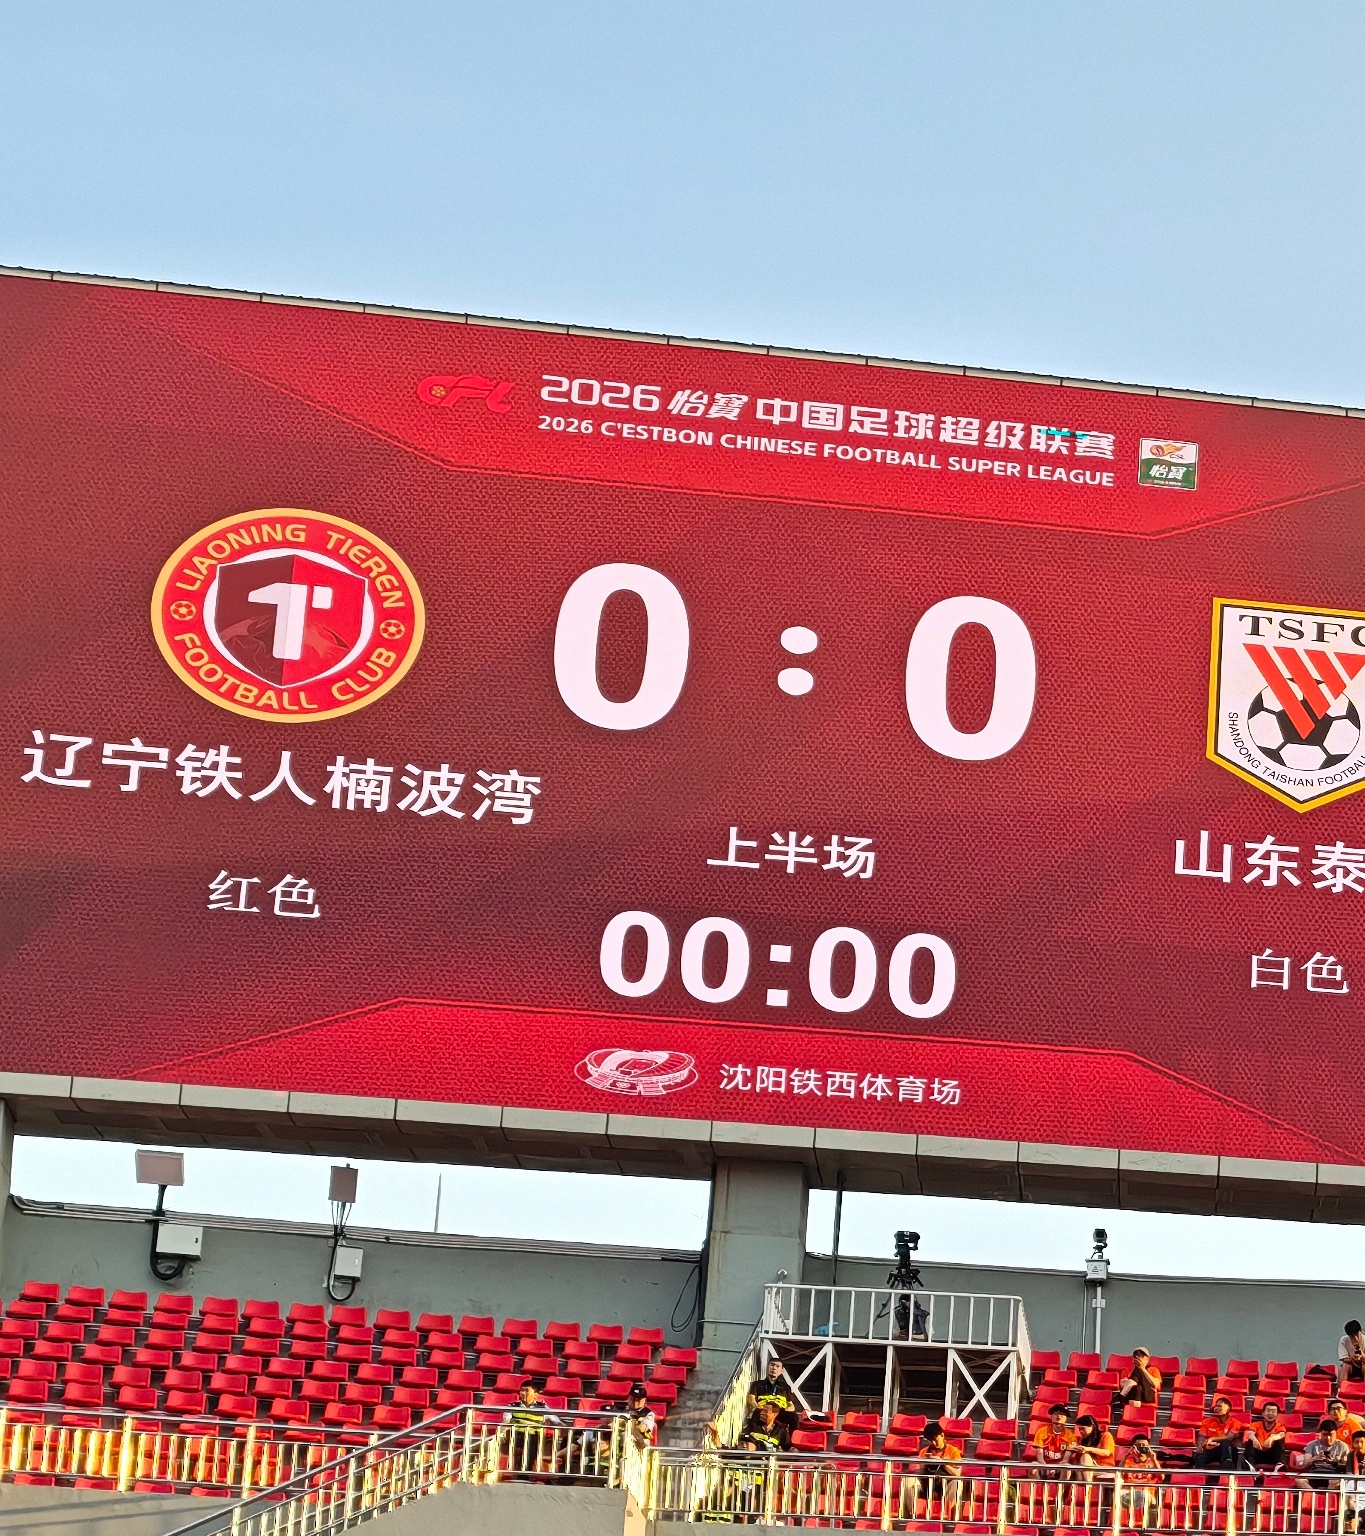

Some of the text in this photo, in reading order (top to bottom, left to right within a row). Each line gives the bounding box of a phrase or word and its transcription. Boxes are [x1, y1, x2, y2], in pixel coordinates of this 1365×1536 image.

[537, 415, 1115, 488] 2026 C'ESTBON CHINESE FOOTBALL SUPER LEAGUE
[539, 374, 663, 412] 2026
[754, 396, 1117, 460] 中国足球超级联赛
[176, 523, 405, 609] LIAONING TIEREN
[174, 632, 397, 710] FOOTBALL CLUB
[553, 562, 691, 732] 0
[904, 595, 1038, 762] 0
[21, 728, 543, 828] 辽宁铁人楠波湾
[1228, 711, 1261, 770] SHANDONG
[1263, 765, 1315, 787] TAISHAN
[706, 825, 876, 881] 上半场
[206, 868, 322, 921] 红色
[599, 909, 957, 1019] 00:00
[1248, 947, 1351, 995] 白色
[718, 1062, 962, 1106] 沈阳铁西体育场
